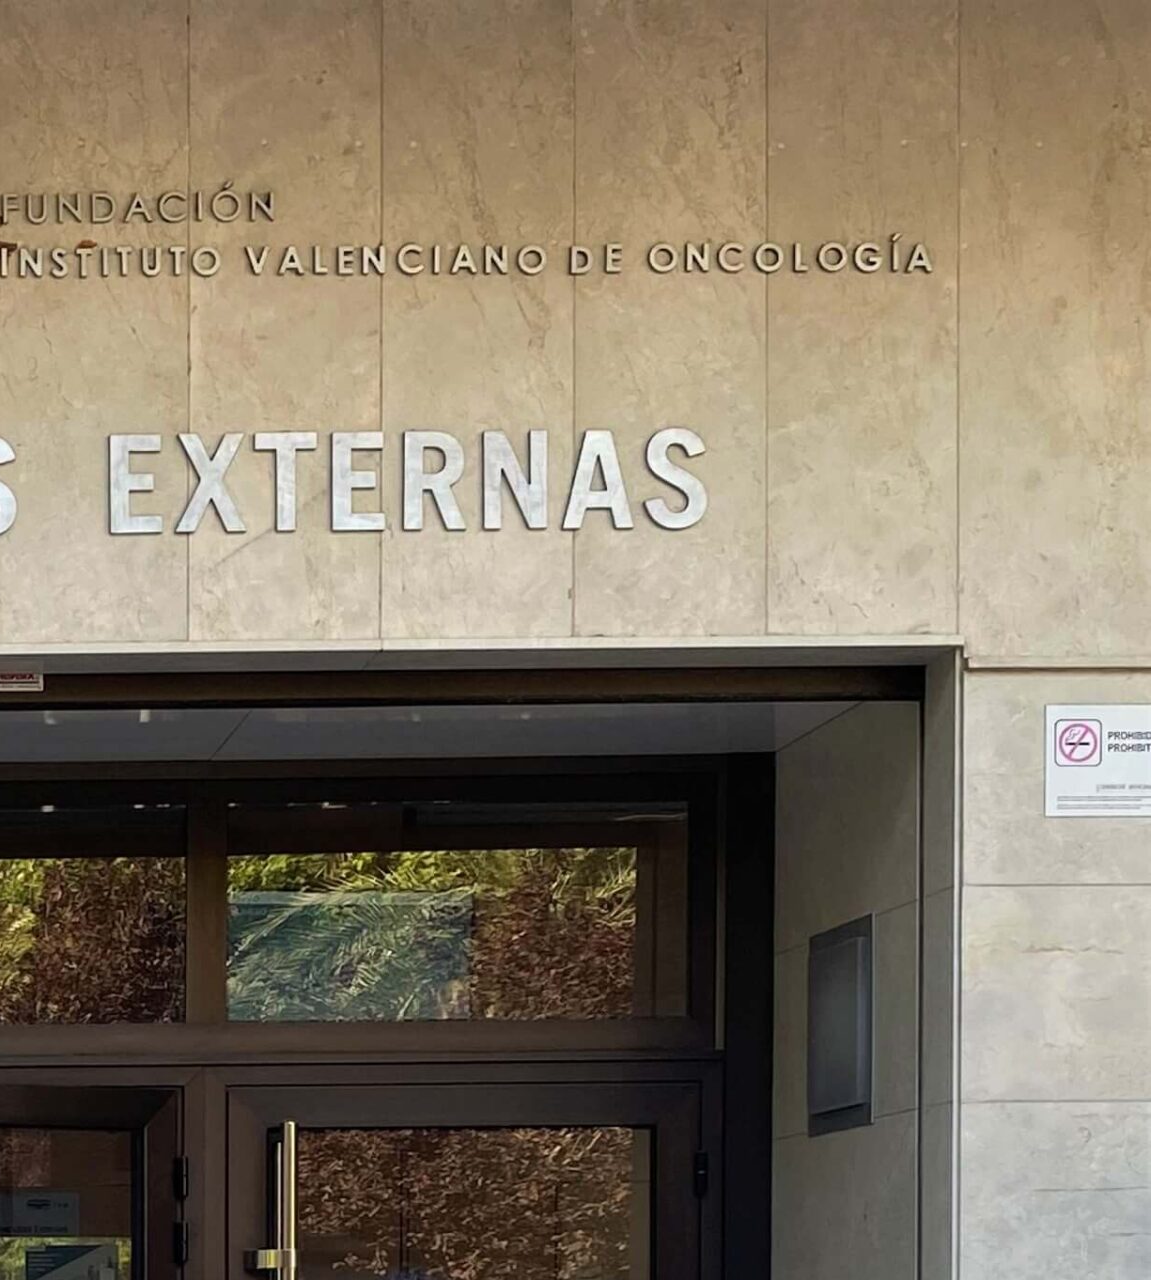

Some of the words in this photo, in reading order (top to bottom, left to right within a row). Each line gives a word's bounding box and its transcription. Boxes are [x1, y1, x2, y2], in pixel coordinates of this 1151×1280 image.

[2, 181, 275, 225] FUNDACIÓN
[0, 245, 222, 278] INSTITUTO
[245, 244, 547, 276] VALENCIANO
[569, 243, 624, 275] DE
[648, 233, 933, 274] ONCOLOGÍA
[107, 428, 710, 536] EXTERNAS
